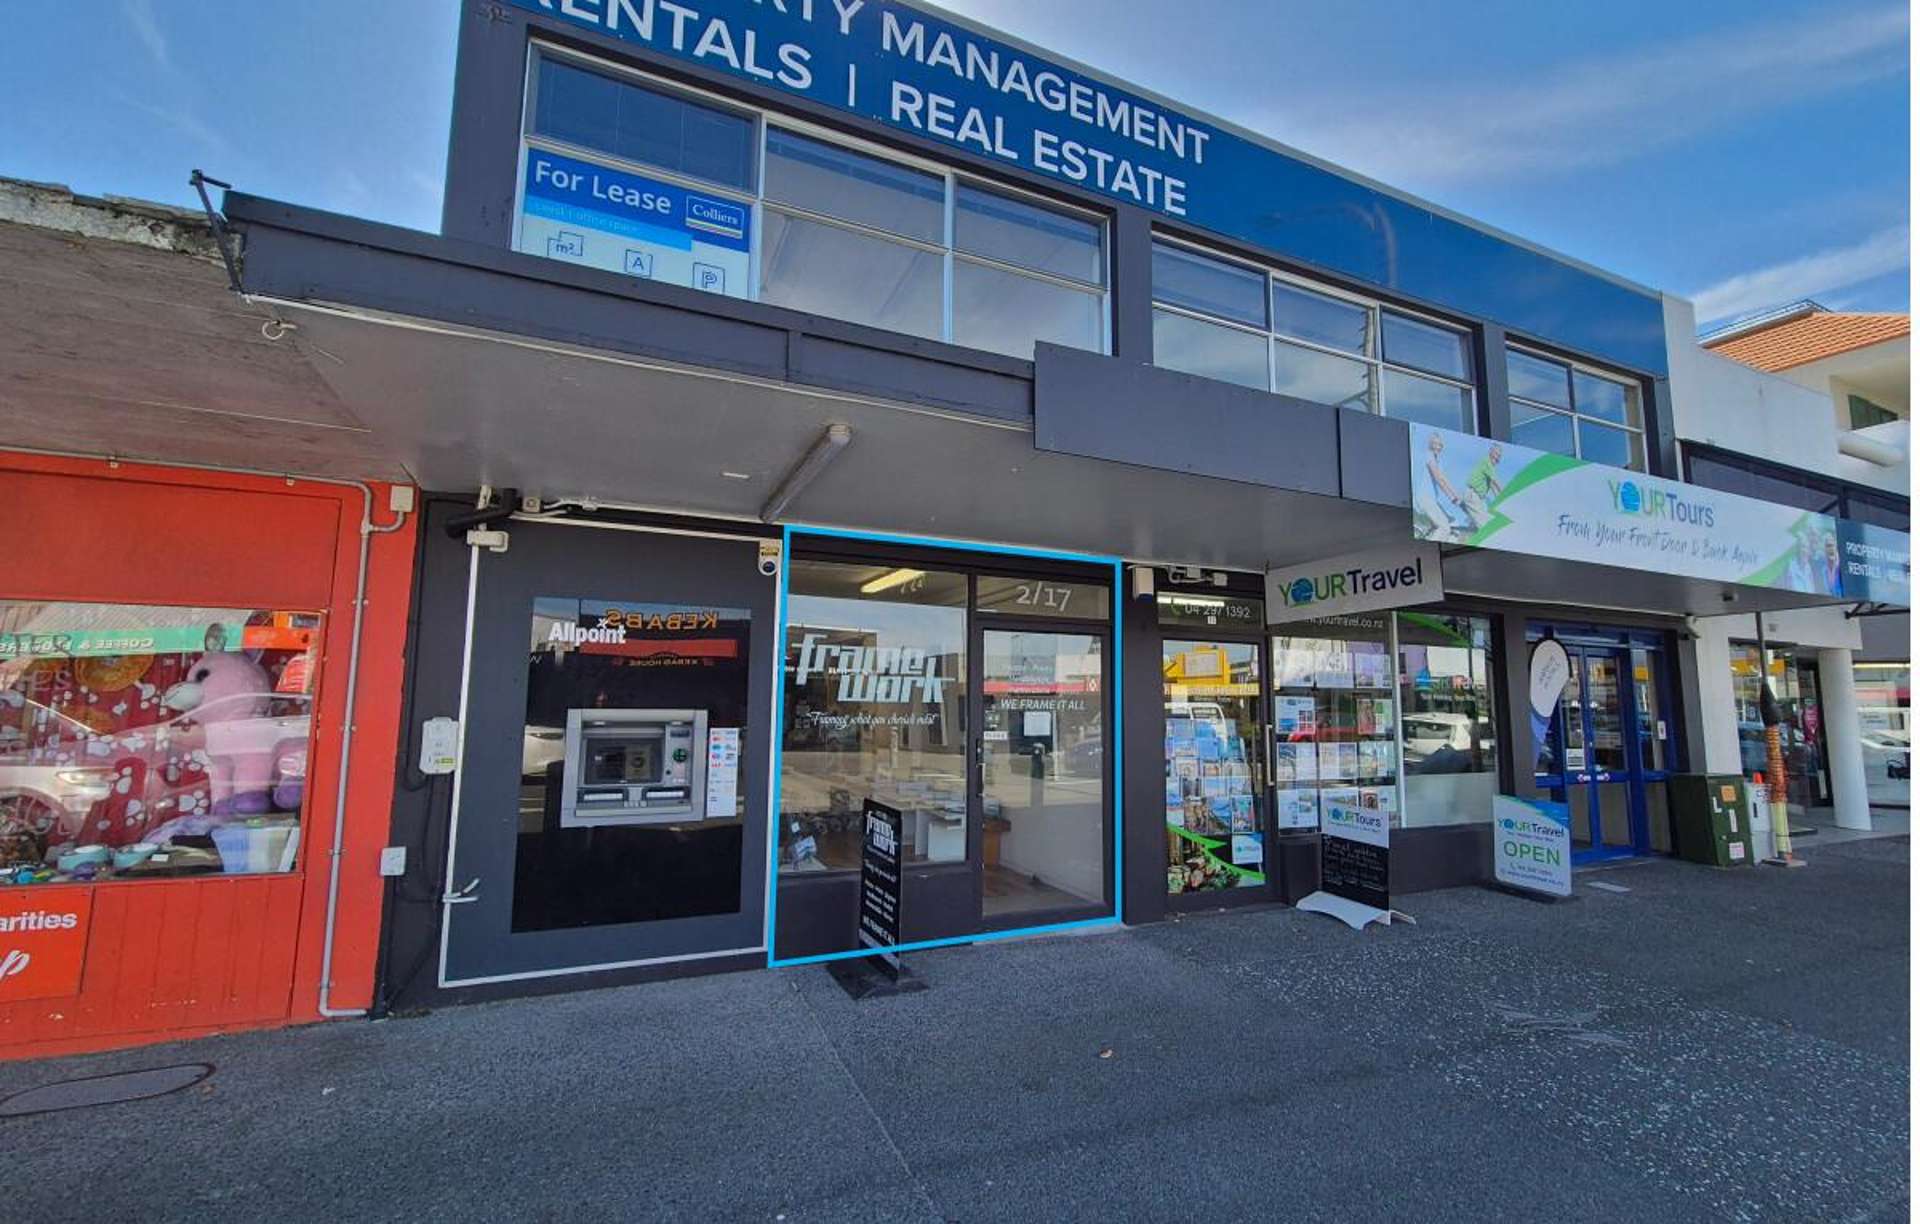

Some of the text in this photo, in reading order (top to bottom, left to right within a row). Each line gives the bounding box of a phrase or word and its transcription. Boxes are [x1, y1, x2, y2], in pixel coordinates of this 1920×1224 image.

[882, 11, 1210, 164] MANAGEMENT
[891, 80, 1018, 160] REAL
[1033, 129, 1188, 216] ESTATE
[535, 160, 671, 214] For Lease
[692, 204, 739, 225] Colliers
[1607, 479, 1715, 528] YOURTours
[1016, 581, 1072, 612] 2/17
[1278, 557, 1423, 607] YOURTravel
[1226, 606, 1251, 618] 1392
[549, 617, 627, 648] Allpoint
[1000, 698, 1086, 711] WE FRAME IT ALL
[1503, 840, 1560, 867] OPEN
